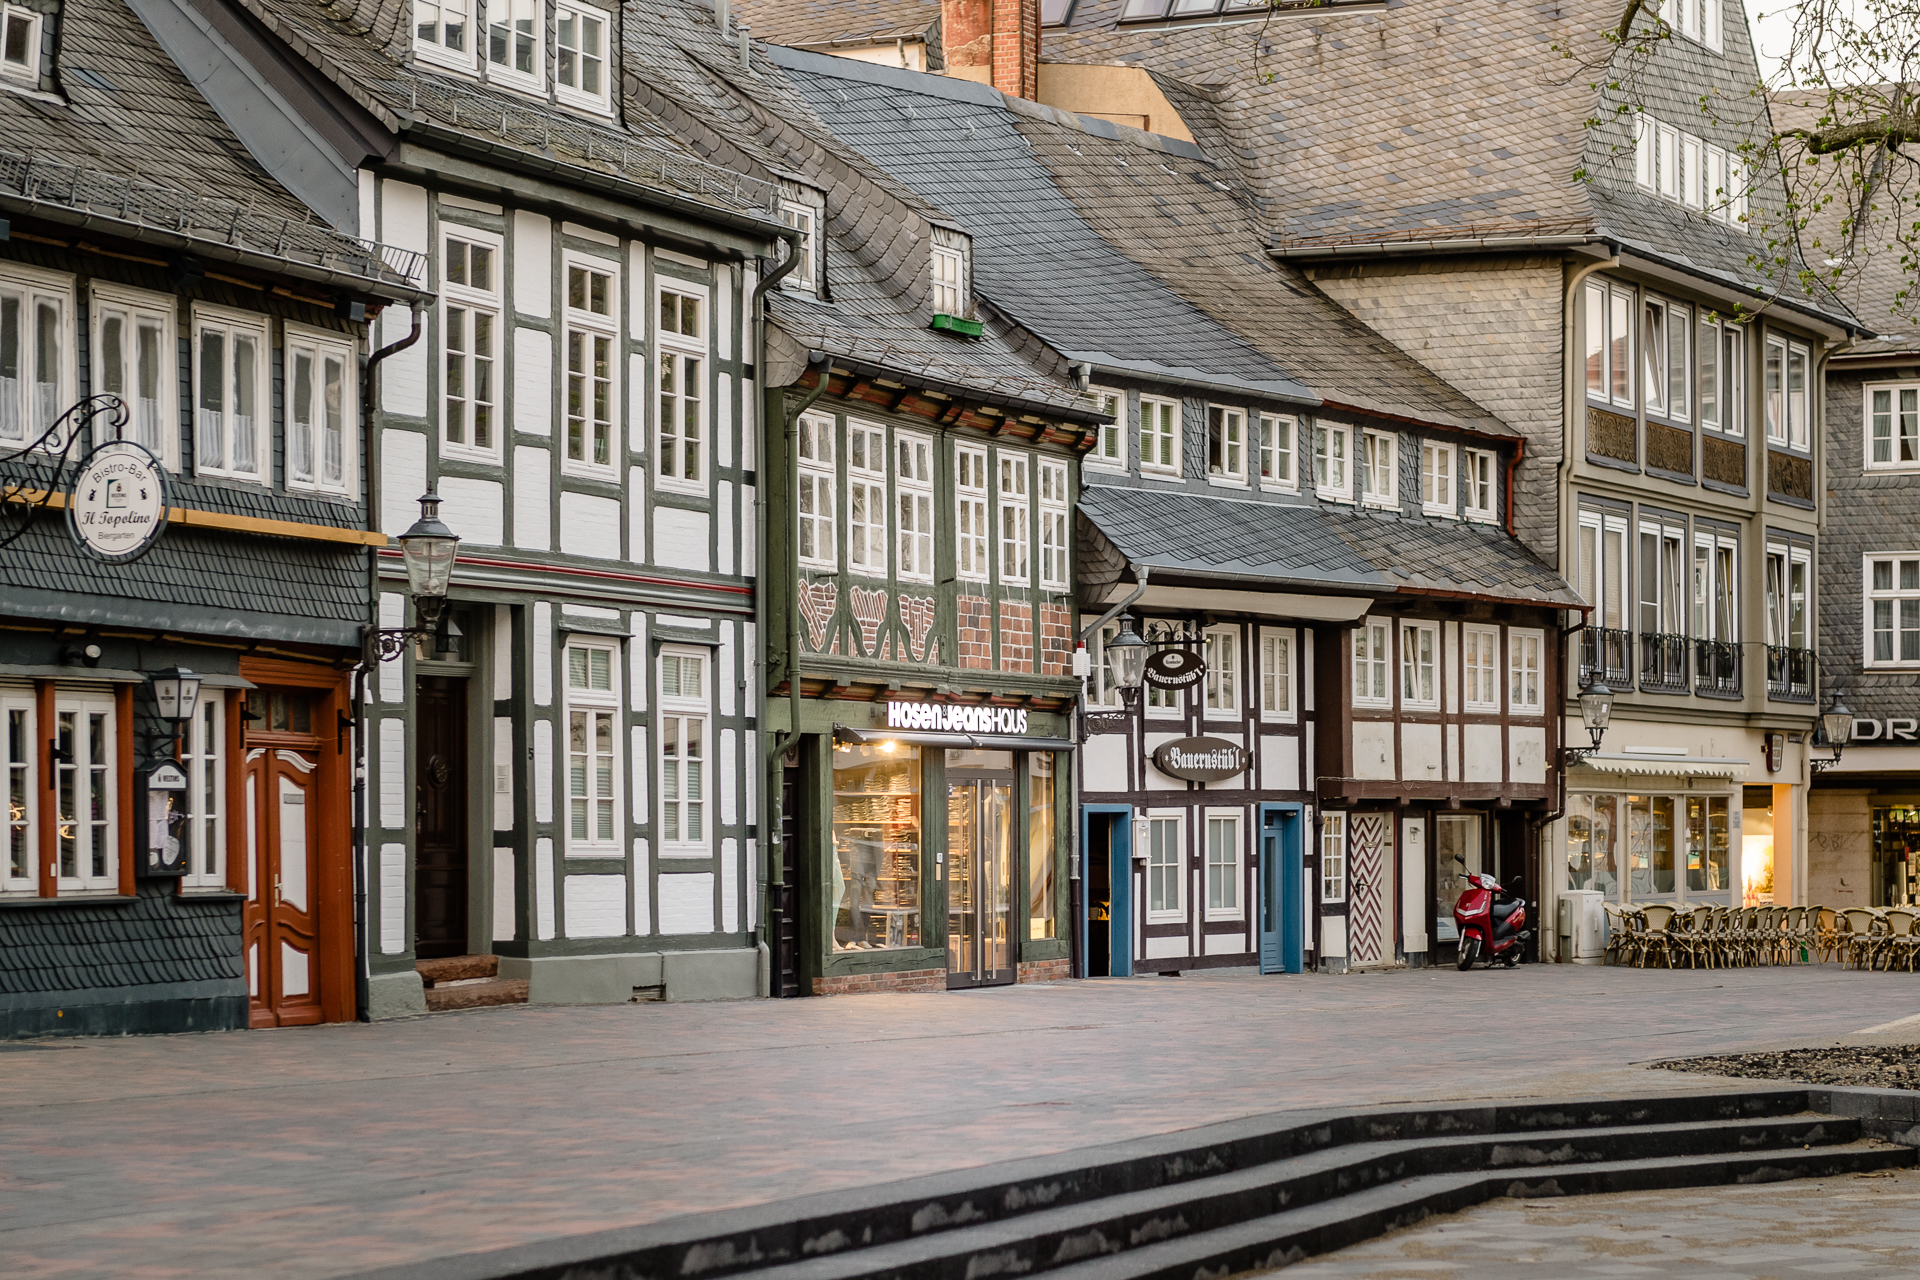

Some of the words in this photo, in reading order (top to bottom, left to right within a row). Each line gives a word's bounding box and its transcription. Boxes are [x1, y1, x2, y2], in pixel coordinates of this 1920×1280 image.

[92, 463, 147, 483] Bistro-Bar
[82, 511, 96, 525] Il
[98, 511, 151, 528] Topolino
[98, 531, 135, 541] Biergarten
[1851, 718, 1919, 740] DR
[528, 747, 534, 760] 5
